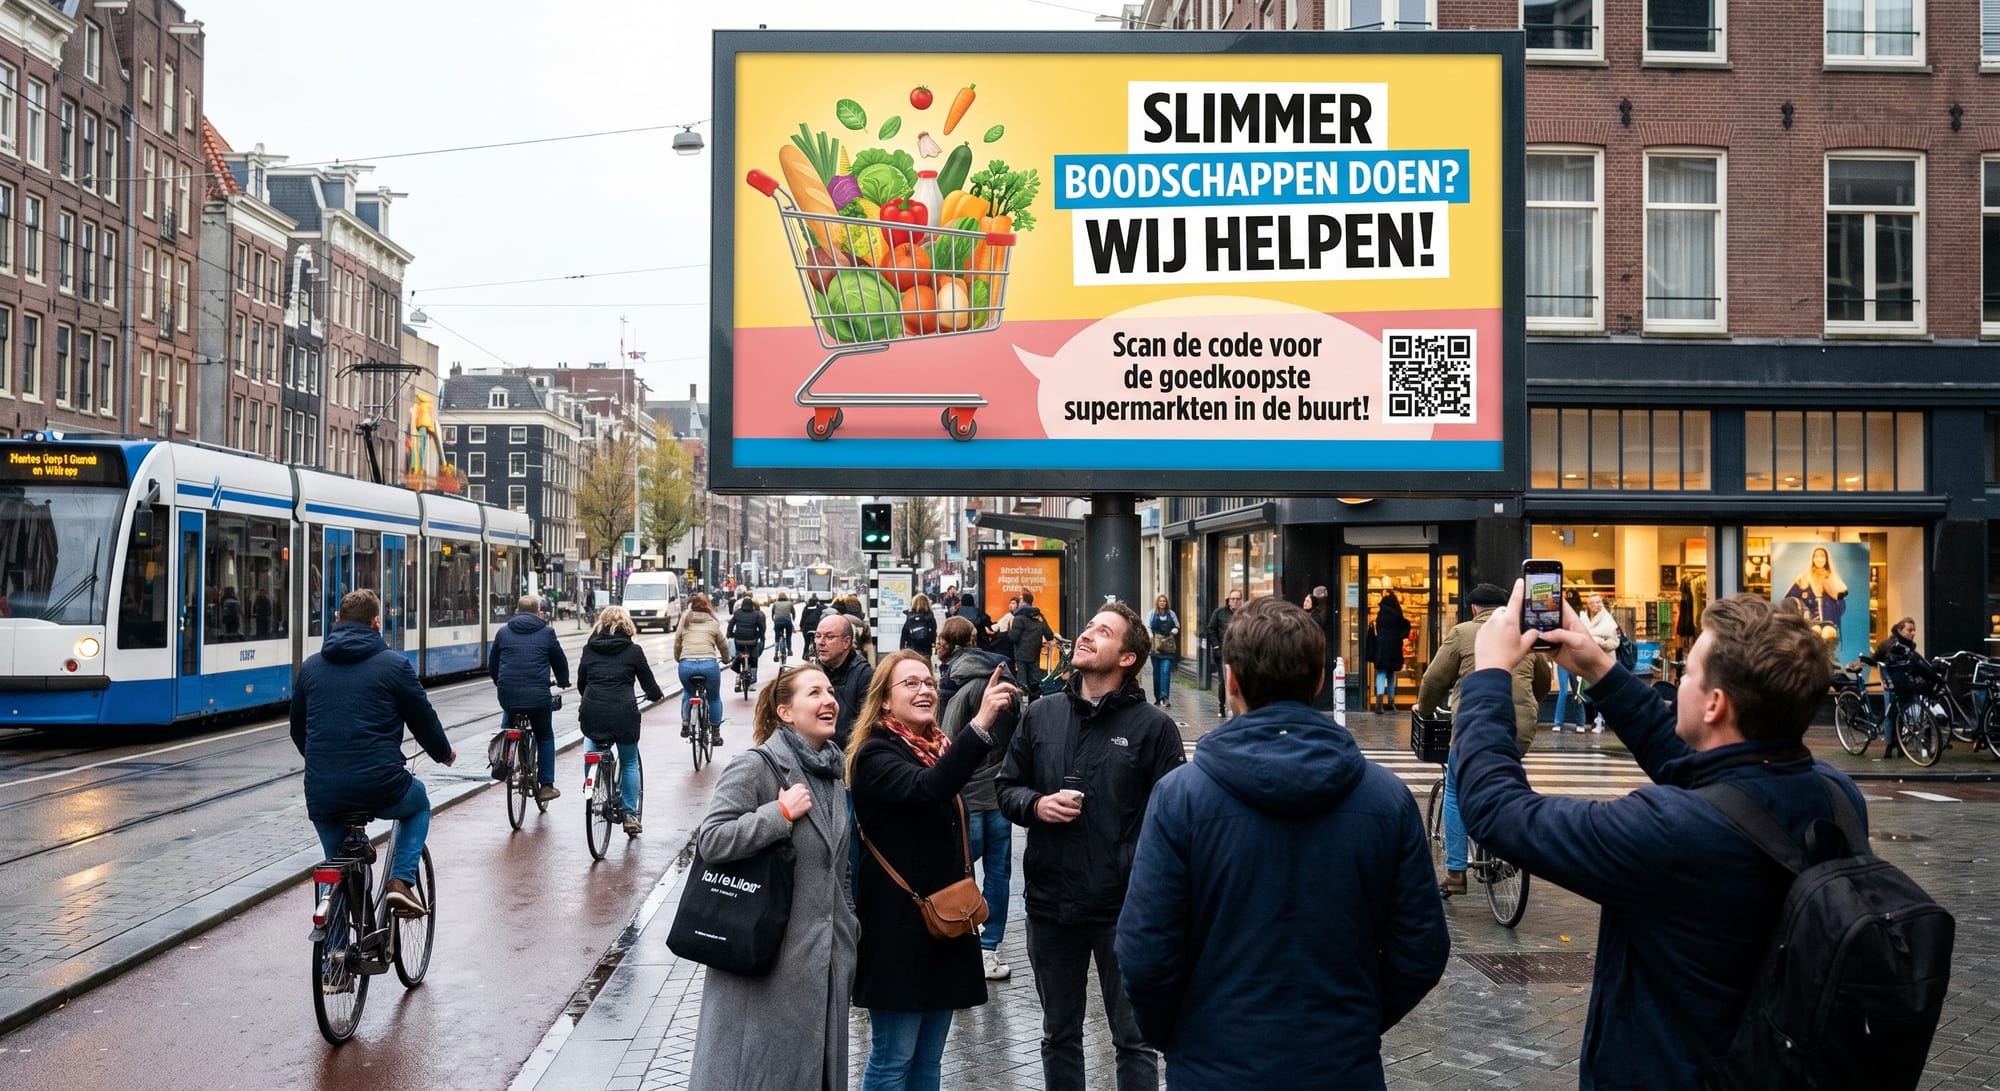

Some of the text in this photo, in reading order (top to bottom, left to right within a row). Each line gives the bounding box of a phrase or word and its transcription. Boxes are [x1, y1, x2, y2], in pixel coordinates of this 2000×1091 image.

[1144, 93, 1372, 143] SLIMMER
[1065, 159, 1460, 199] BOODSCHAPPEN DOEN?
[1086, 212, 1435, 274] WIJ HELPEN!
[1113, 332, 1323, 358] Scan de code voor
[1124, 364, 1311, 394] de goedkoopste
[1064, 396, 1370, 425] supermarkten in de buurt!
